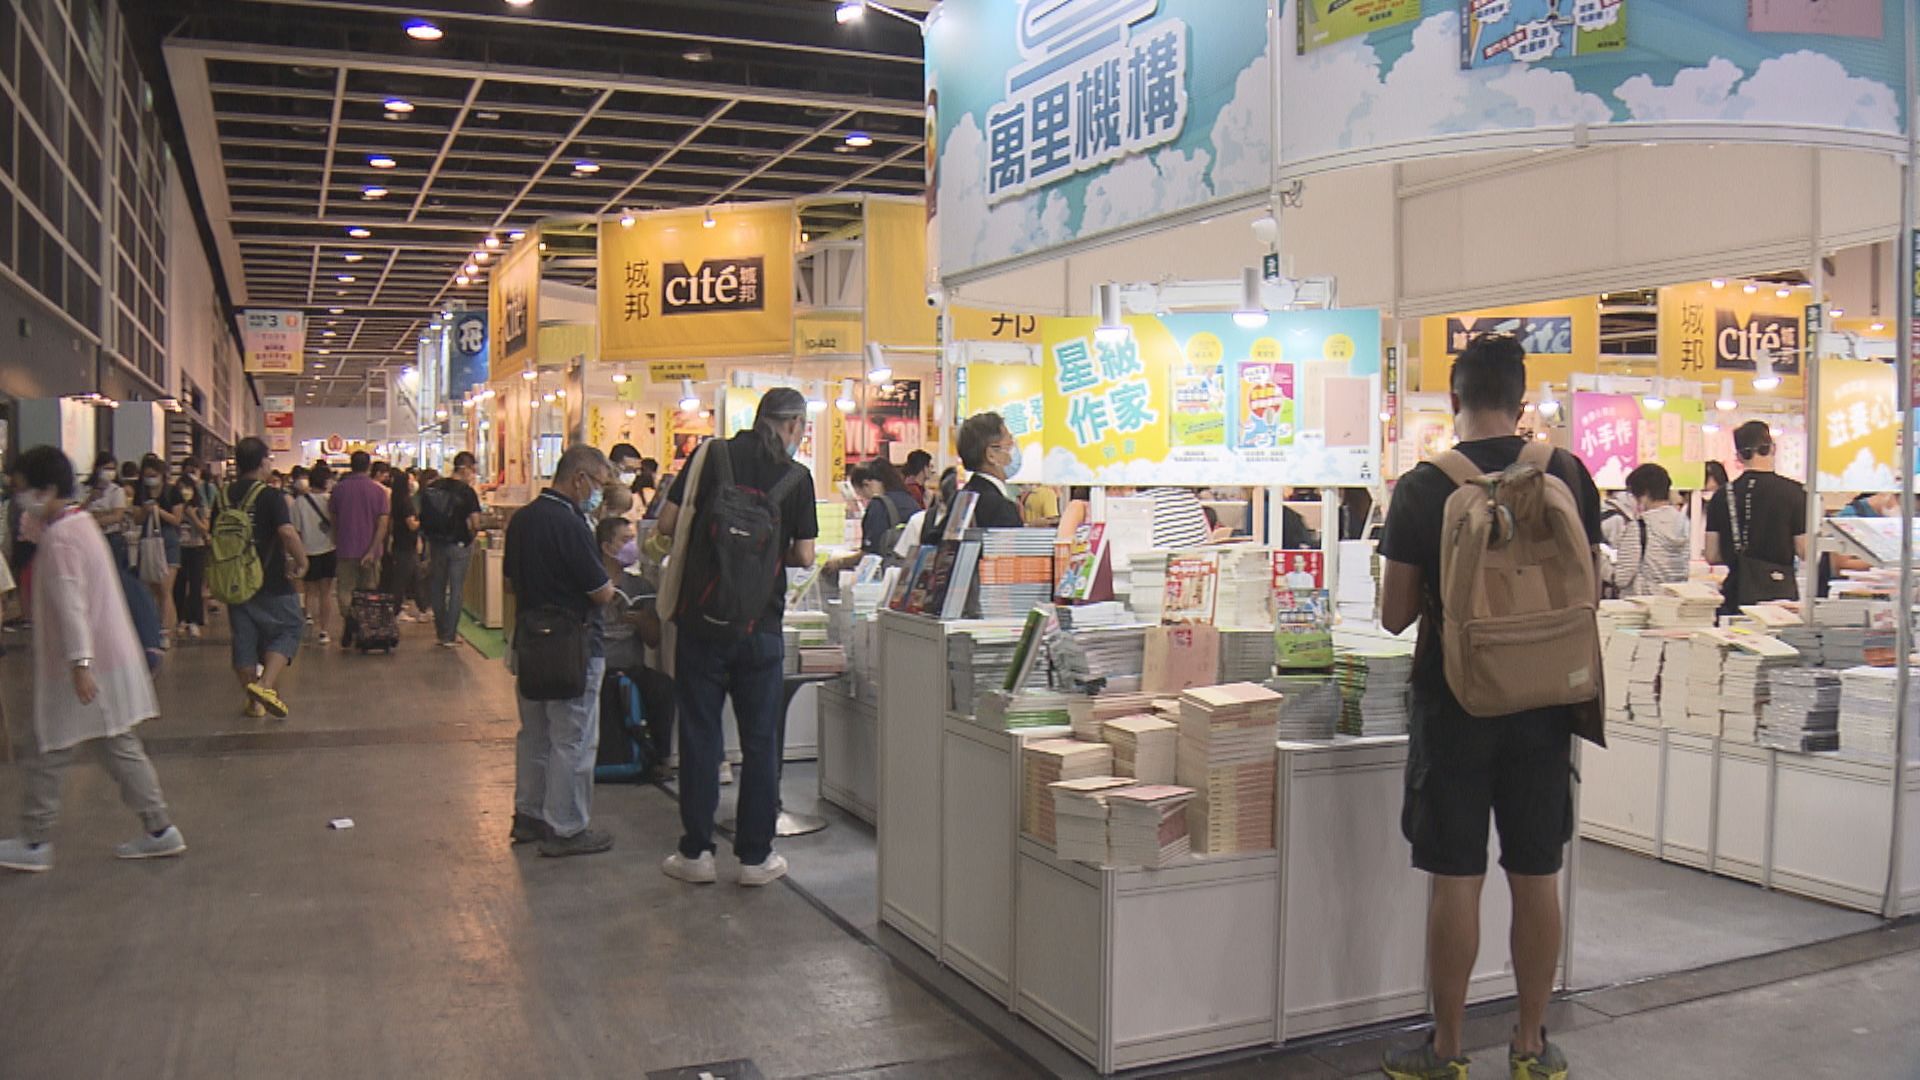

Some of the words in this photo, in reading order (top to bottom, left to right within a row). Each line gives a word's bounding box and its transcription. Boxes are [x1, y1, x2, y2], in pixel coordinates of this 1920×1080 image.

[989, 31, 1178, 194] 萬里機構
[624, 260, 650, 322] 城邦
[665, 265, 738, 306] cité
[268, 315, 278, 328] 3
[1681, 300, 1704, 372] 城邦
[1069, 382, 1154, 445] 作家
[1581, 420, 1633, 457] 小手作
